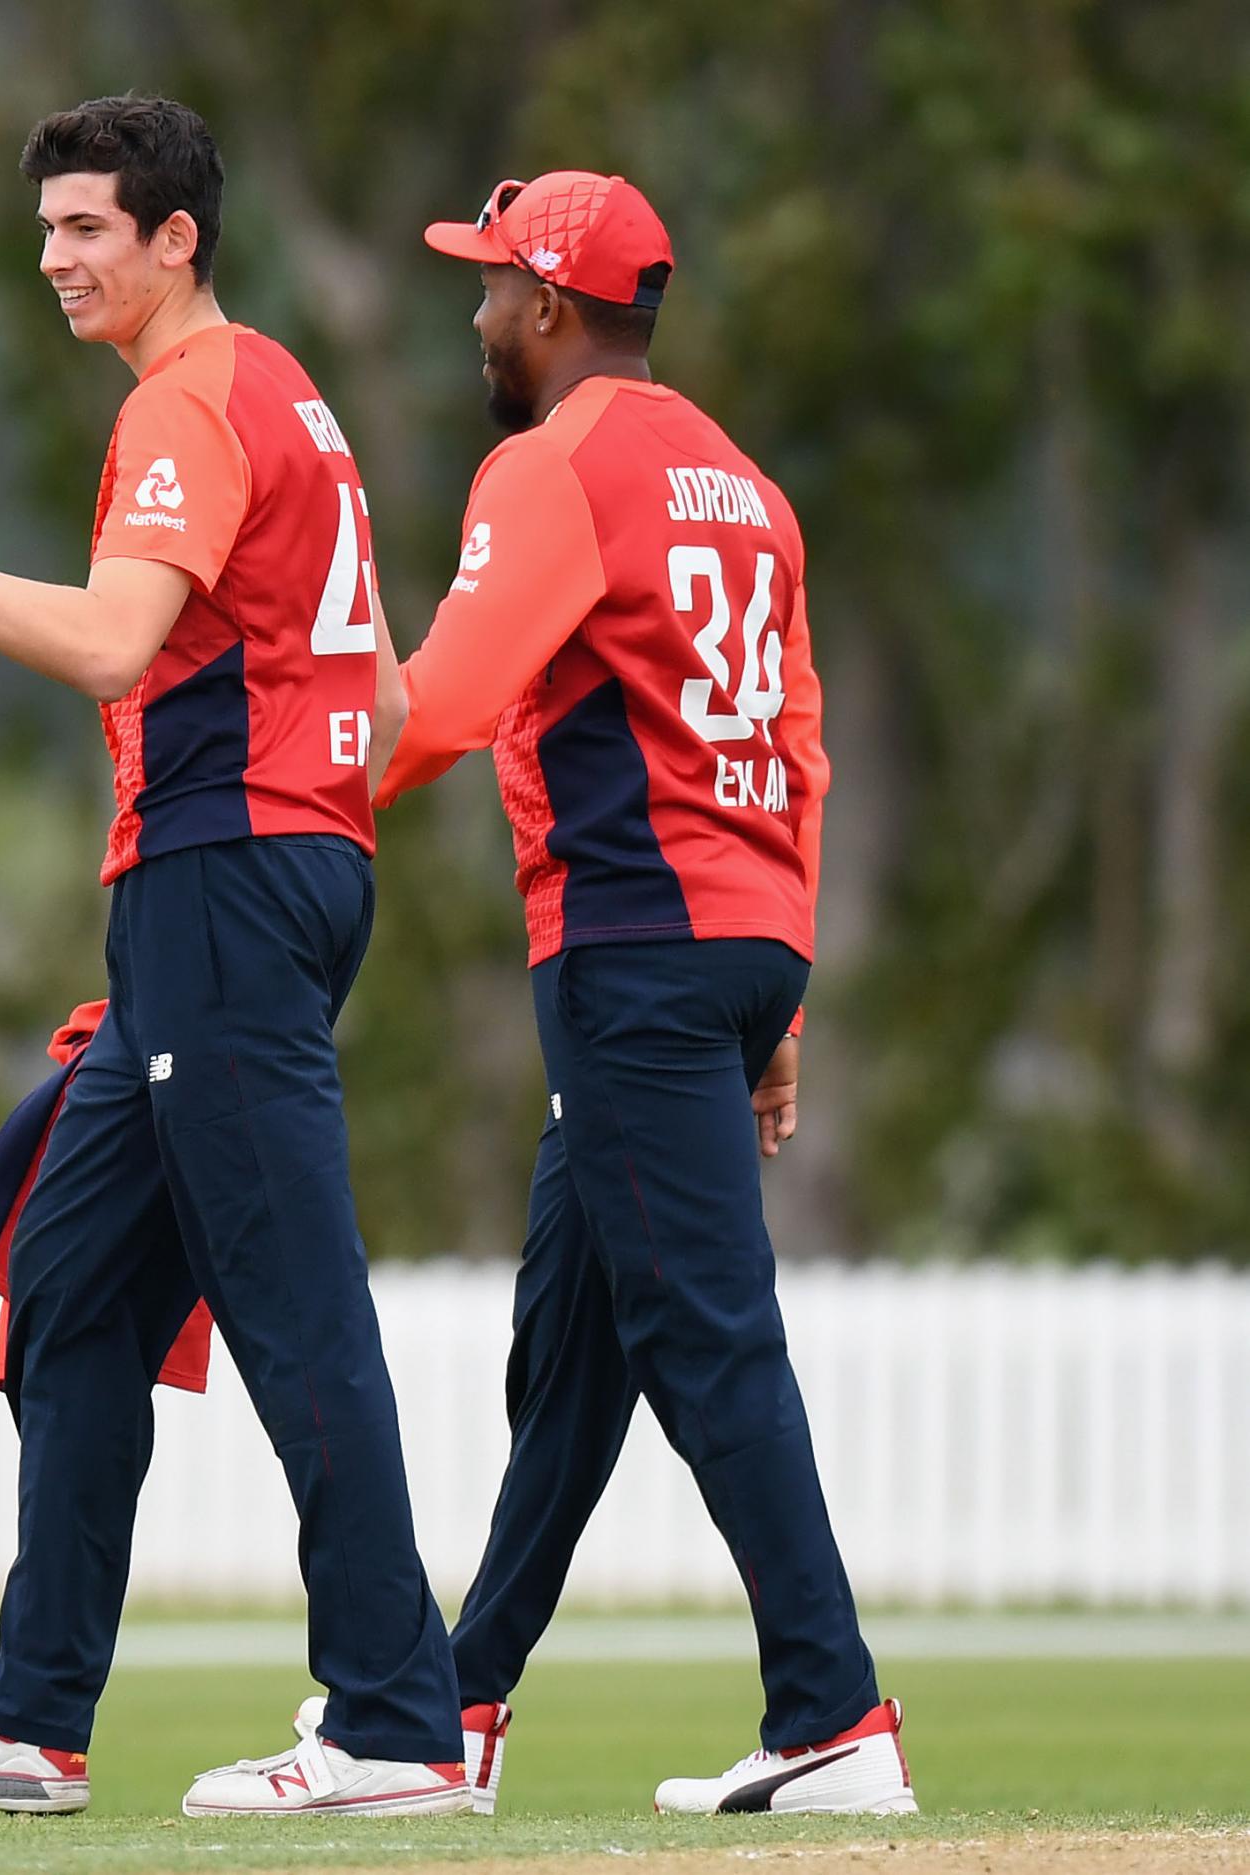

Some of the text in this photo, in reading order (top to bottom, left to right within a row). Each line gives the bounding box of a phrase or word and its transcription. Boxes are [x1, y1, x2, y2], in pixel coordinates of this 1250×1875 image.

[292, 399, 351, 458] BRO
[124, 511, 187, 533] NatWest
[665, 467, 772, 530] JORDAN
[310, 481, 377, 656] 4
[667, 545, 786, 747] 34
